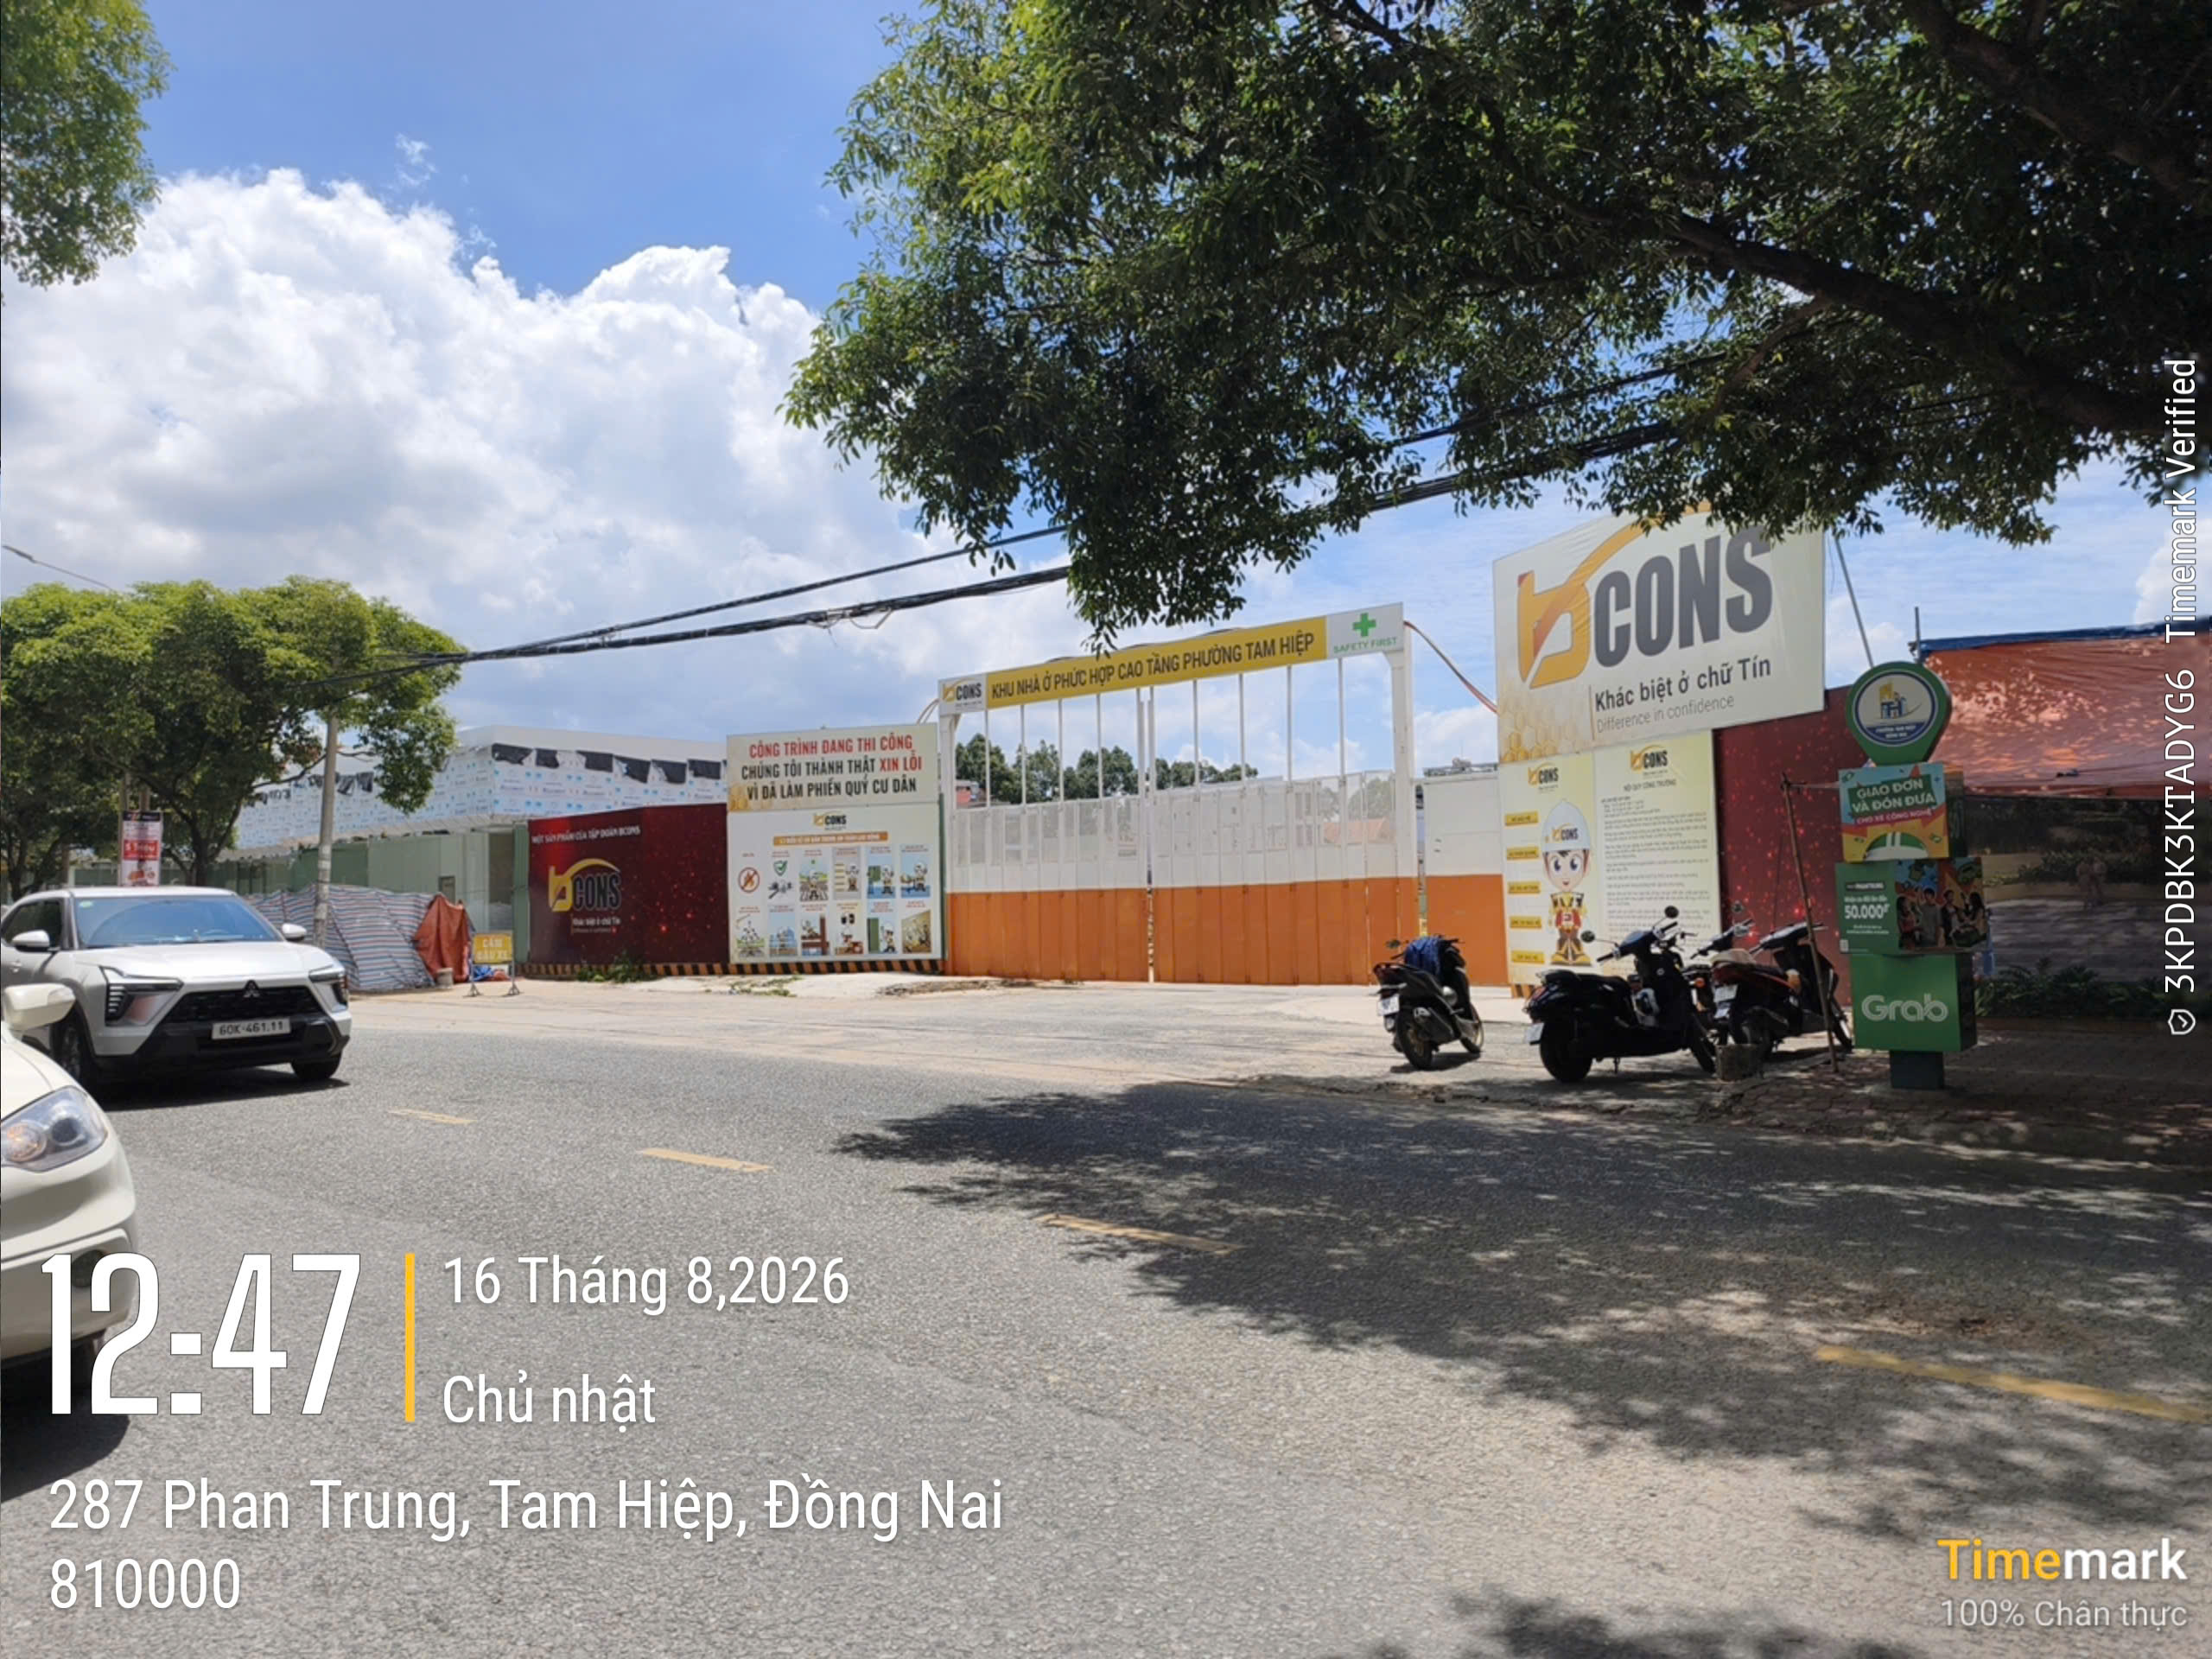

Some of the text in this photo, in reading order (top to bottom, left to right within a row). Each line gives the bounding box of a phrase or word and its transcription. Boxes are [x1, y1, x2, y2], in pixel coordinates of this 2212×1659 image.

[1333, 637, 1398, 653] SAFETY FIRST
[992, 630, 1314, 699] KHU NHÀ Ở PHỨC HỢP CAO TẦNG PHƯỜNG TAM HIỆP
[1595, 656, 1771, 712] Khác biệt ở chữ Tín
[1597, 695, 1734, 734] Difference in confidence
[750, 733, 912, 759] CÔNG TRÌNH ĐANG THI CÔNG
[741, 760, 780, 780] CHÚNG
[784, 760, 801, 778] TÔI
[805, 758, 843, 776] THÀNH
[880, 757, 899, 772] XIN
[747, 784, 758, 800] VÌ
[762, 782, 777, 799] ĐÃ
[780, 780, 803, 799] LÀM
[845, 773, 869, 797] QUÝ
[893, 774, 917, 792] DÂN
[1857, 779, 1923, 799] GIAO ĐƠN
[1853, 792, 1936, 812] VÀ ĐÓN ĐƯA
[1861, 993, 1948, 1022] Grab
